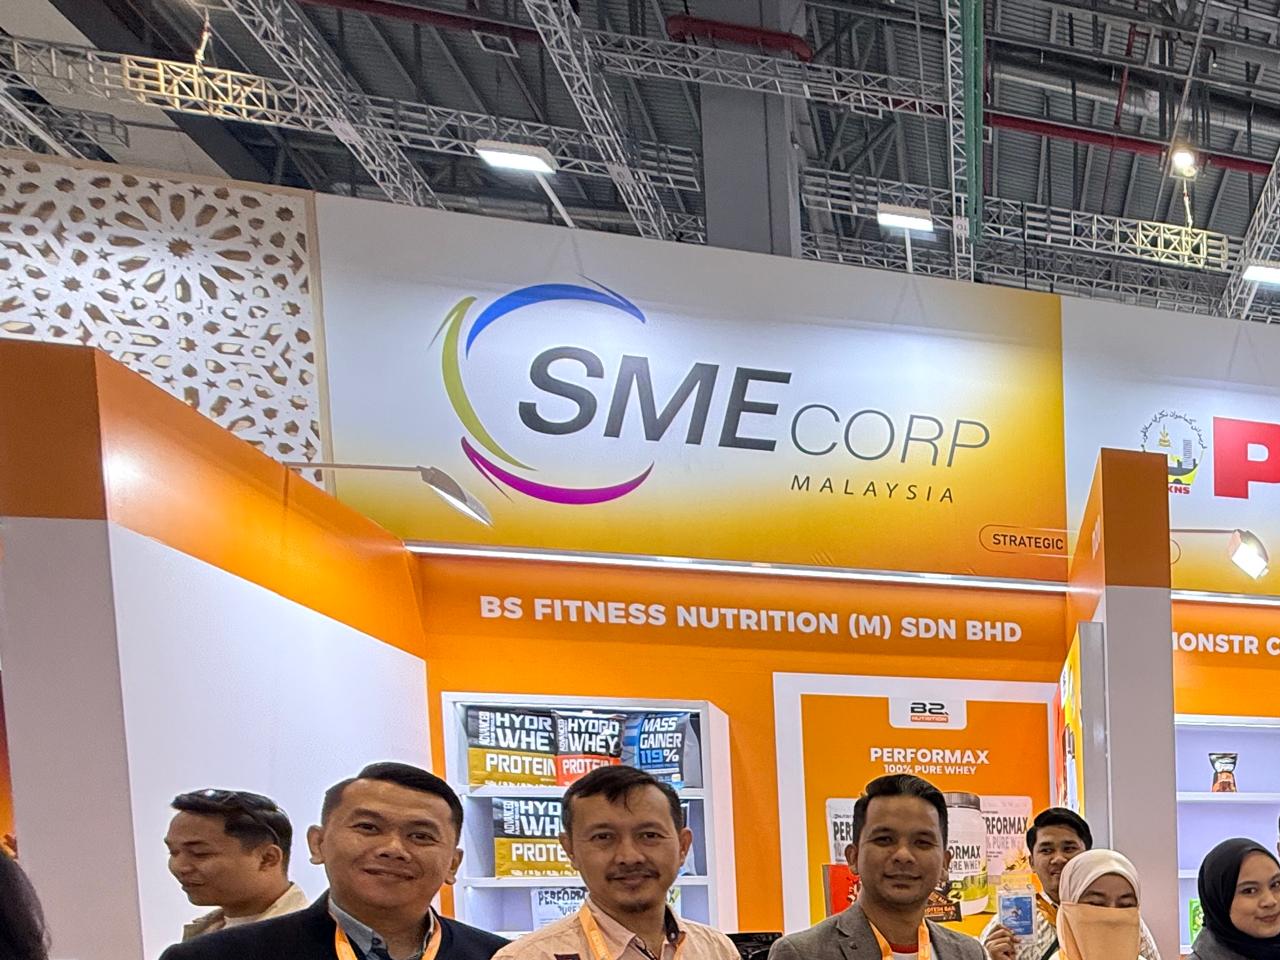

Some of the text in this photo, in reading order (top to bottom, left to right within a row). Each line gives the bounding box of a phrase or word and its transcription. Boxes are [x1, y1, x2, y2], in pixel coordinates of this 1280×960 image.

[790, 474, 954, 503] MALAYSIA
[1167, 485, 1190, 494] KNS
[992, 533, 1064, 550] STRATEGIC
[480, 596, 1022, 643] BS FITNESS NUTRITION (M) SDN BHD
[1172, 632, 1259, 655] ONSTR
[495, 712, 553, 731] HYDR
[567, 718, 620, 735] HYDRO
[641, 717, 678, 732] MASS
[495, 728, 555, 751] WHE
[568, 733, 618, 755] WHEY
[640, 733, 682, 749] GAINER
[640, 749, 679, 763] 119%
[870, 747, 990, 764] PERFORMAX
[884, 764, 977, 775] 100% PURE WHEY
[519, 800, 562, 816] HYD
[983, 816, 1028, 835] RFORMAX
[511, 843, 568, 862] PROTE
